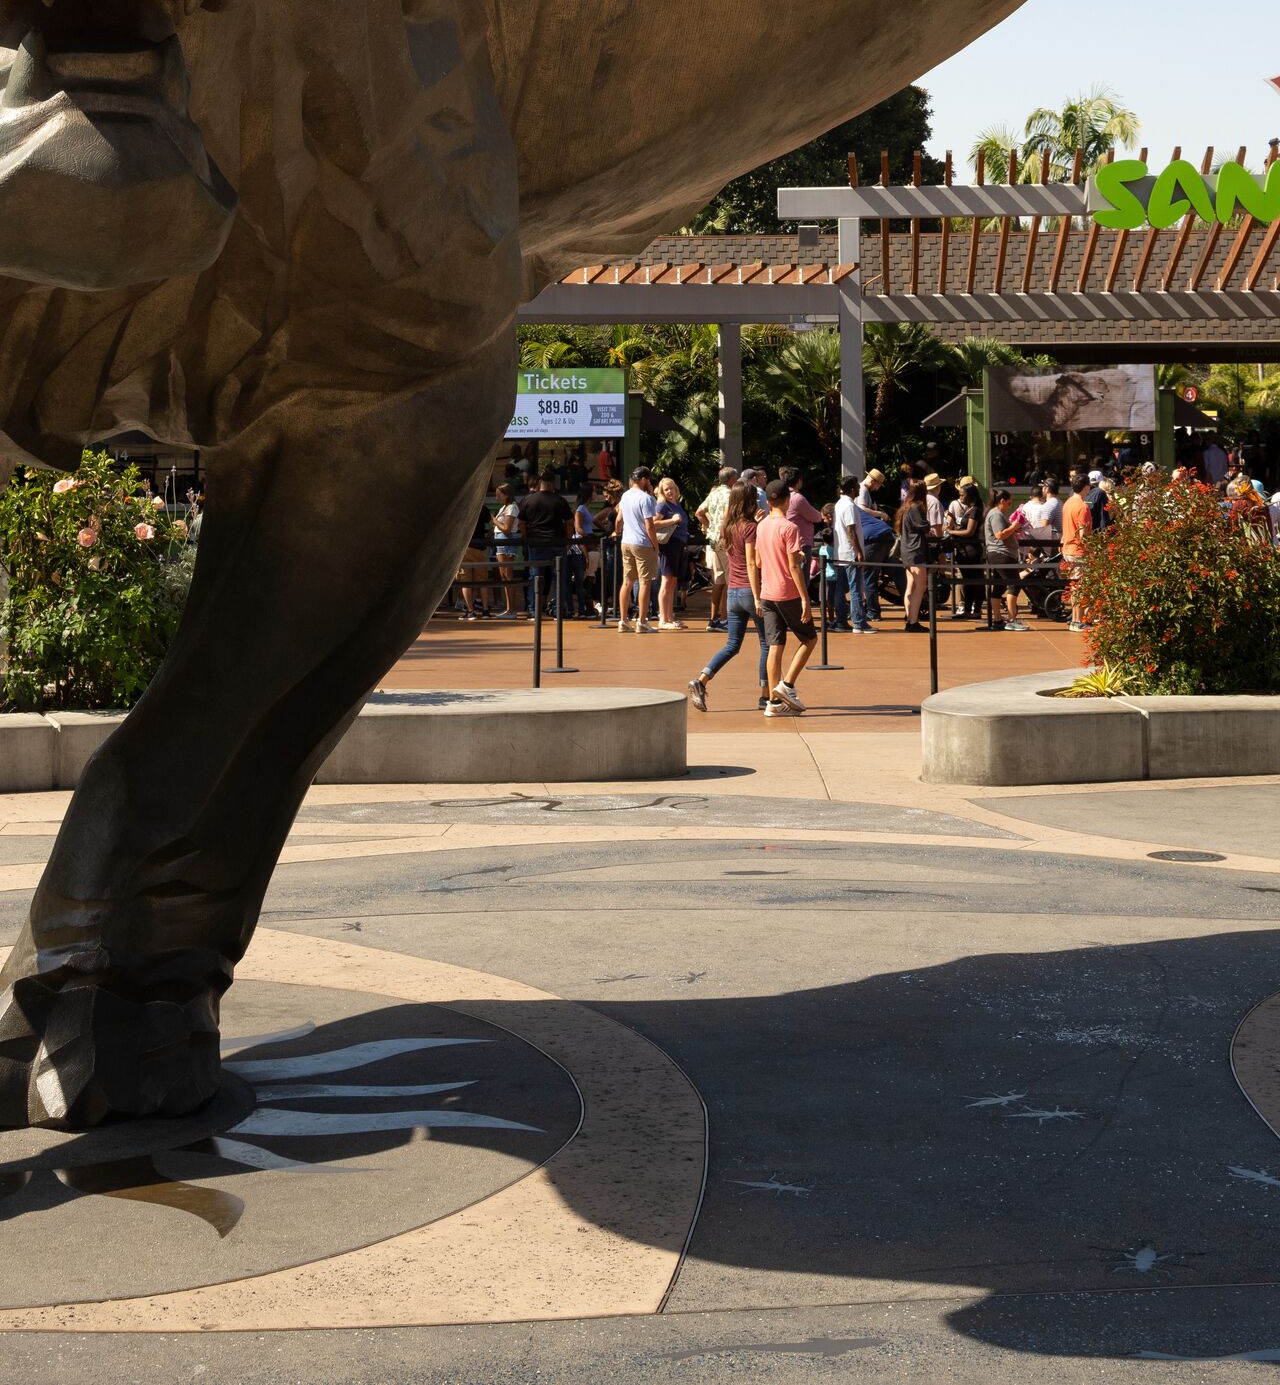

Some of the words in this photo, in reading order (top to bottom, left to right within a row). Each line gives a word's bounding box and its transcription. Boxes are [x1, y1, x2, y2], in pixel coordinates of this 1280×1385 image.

[524, 374, 587, 389] Tickets
[1186, 390, 1193, 399] 4
[538, 398, 578, 415] $89.60
[511, 416, 529, 425] ass
[541, 418, 553, 426] Ages
[994, 434, 1008, 445] 10
[1140, 434, 1148, 445] 9
[114, 448, 128, 460] 14
